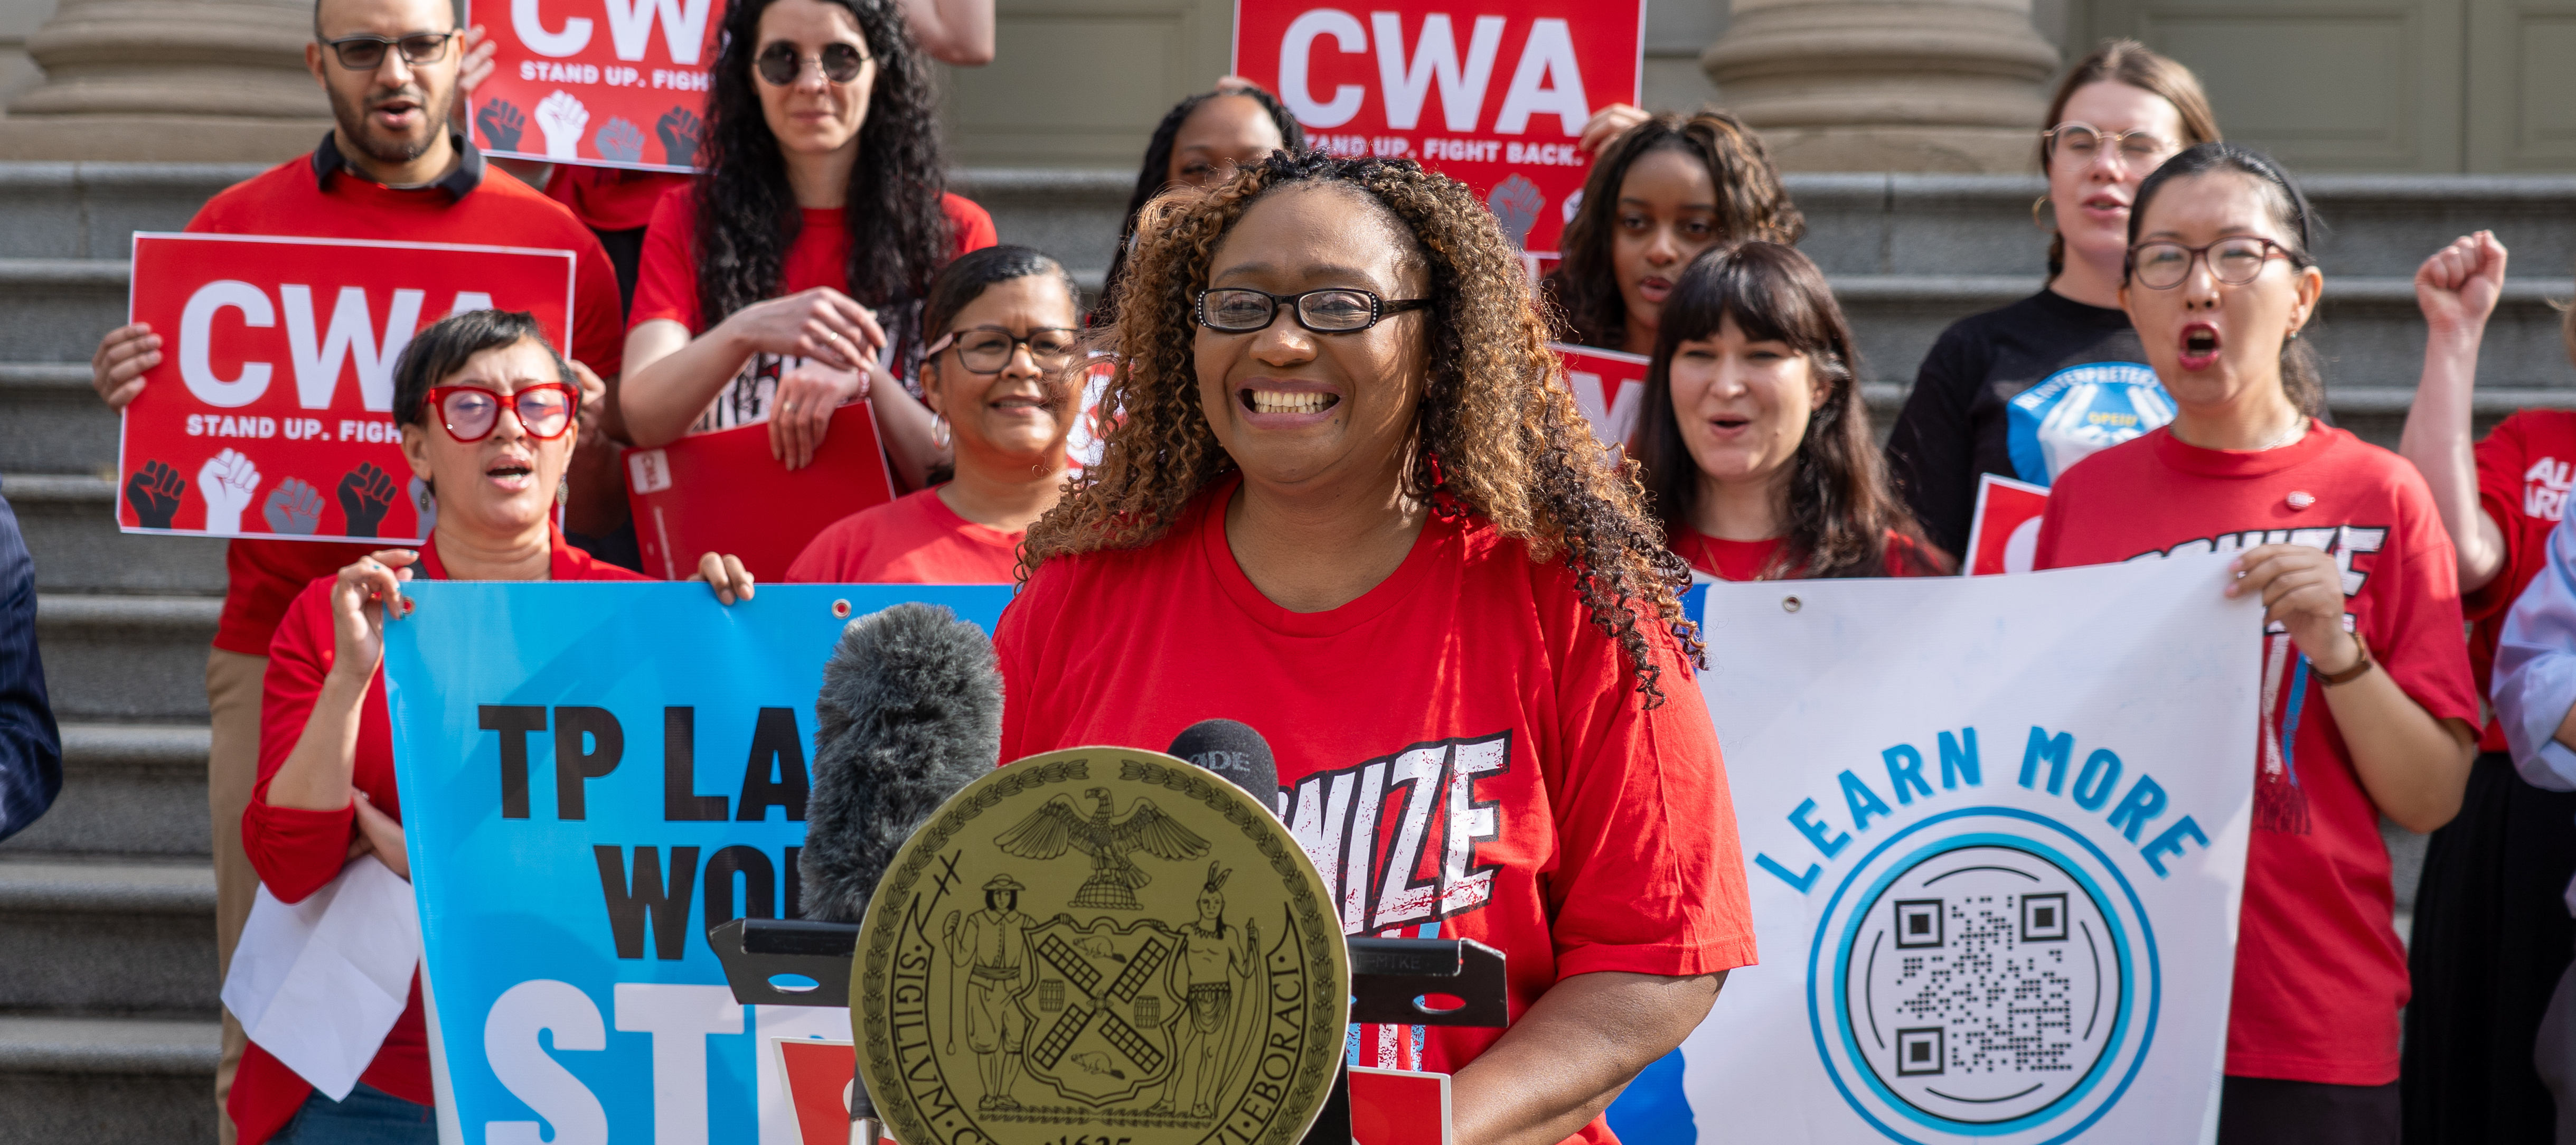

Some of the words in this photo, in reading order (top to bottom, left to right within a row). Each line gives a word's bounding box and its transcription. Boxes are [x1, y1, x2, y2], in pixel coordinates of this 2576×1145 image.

[511, 0, 712, 65] CW
[519, 60, 600, 85] STAND
[605, 65, 647, 88] UP.
[652, 69, 709, 92] FIGH
[1278, 7, 1591, 137] CWA
[1303, 134, 1367, 157] TAND
[1374, 136, 1417, 158] UP.
[1424, 138, 1501, 162] FIGHT
[1506, 141, 1584, 166] BACK.
[178, 279, 494, 412] CW
[2034, 365, 2160, 398] INTERPRETER
[186, 414, 276, 438] STAND
[284, 418, 331, 440] UP.
[340, 420, 402, 444] FIGH
[478, 705, 624, 820] TP
[664, 706, 811, 822] LA
[1189, 750, 1251, 772] ØDE
[1754, 727, 1981, 895] LEARN
[2018, 726, 2210, 879] MORE
[1289, 730, 1511, 936] NIZE
[594, 844, 802, 960] WO
[1240, 968, 1301, 1125] EBORACI
